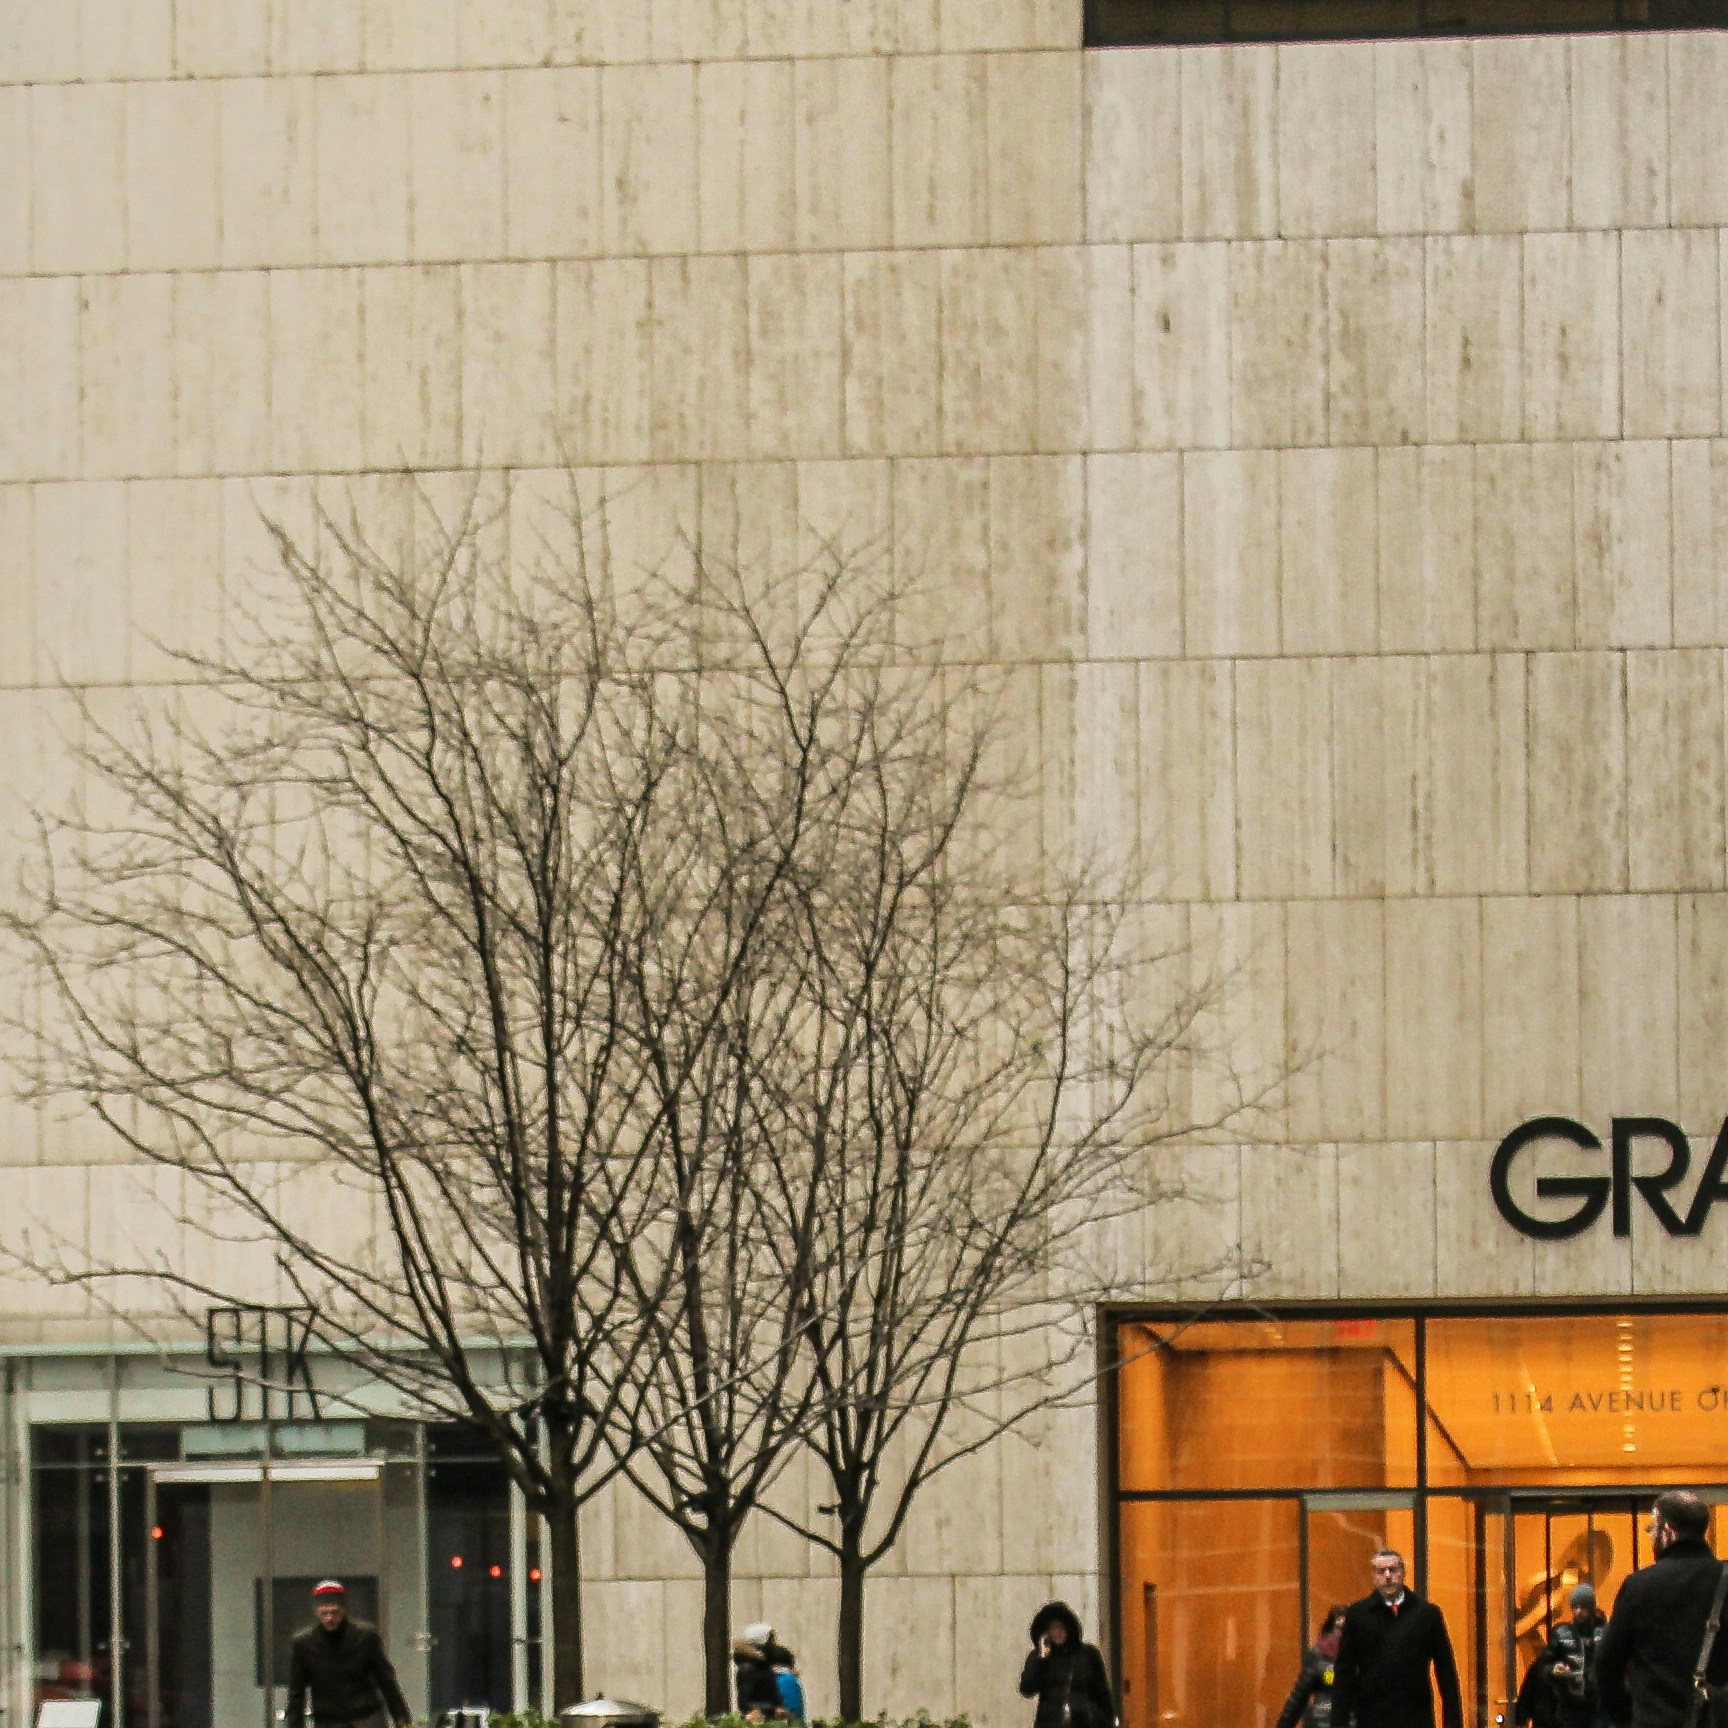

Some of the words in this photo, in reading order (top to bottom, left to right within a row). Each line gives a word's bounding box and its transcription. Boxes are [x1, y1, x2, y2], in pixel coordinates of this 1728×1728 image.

[207, 1306, 322, 1422] STK
[1492, 1390, 1555, 1414] 1114
[1569, 1389, 1683, 1413] AVENUE
